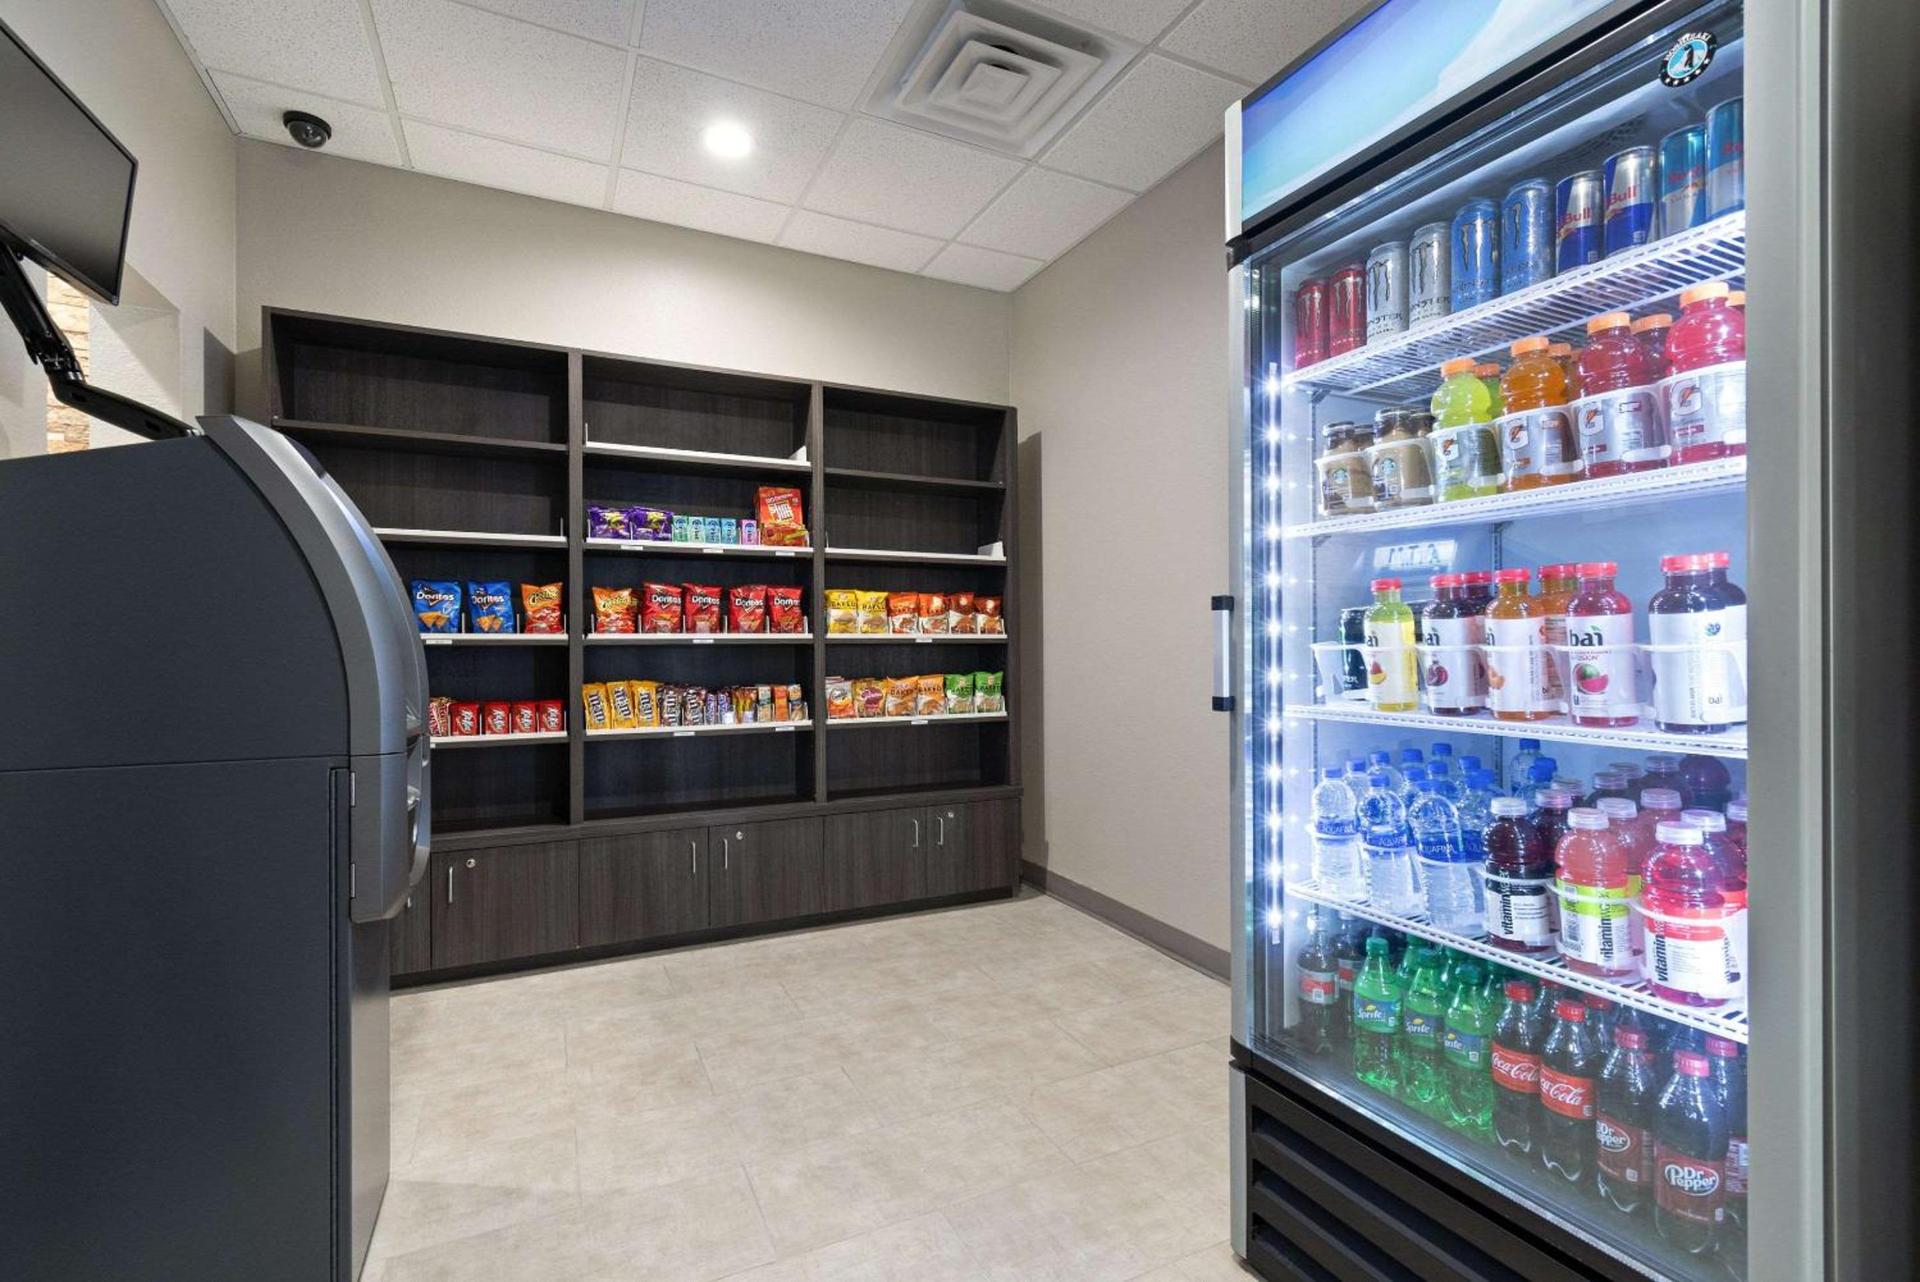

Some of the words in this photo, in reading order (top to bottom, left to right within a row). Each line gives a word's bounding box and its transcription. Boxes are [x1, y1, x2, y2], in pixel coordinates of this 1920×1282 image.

[416, 591, 455, 603] Doritos
[652, 594, 682, 605] Doritos
[692, 595, 721, 606] Doritos
[735, 597, 764, 608] Doritos
[1426, 627, 1440, 646] ai
[1570, 625, 1603, 647] bai
[1358, 1007, 1383, 1020] Sprite
[1405, 1021, 1431, 1034] Sprite
[1670, 1167, 1716, 1192] Pepper
[1693, 1166, 1714, 1180] Dr
